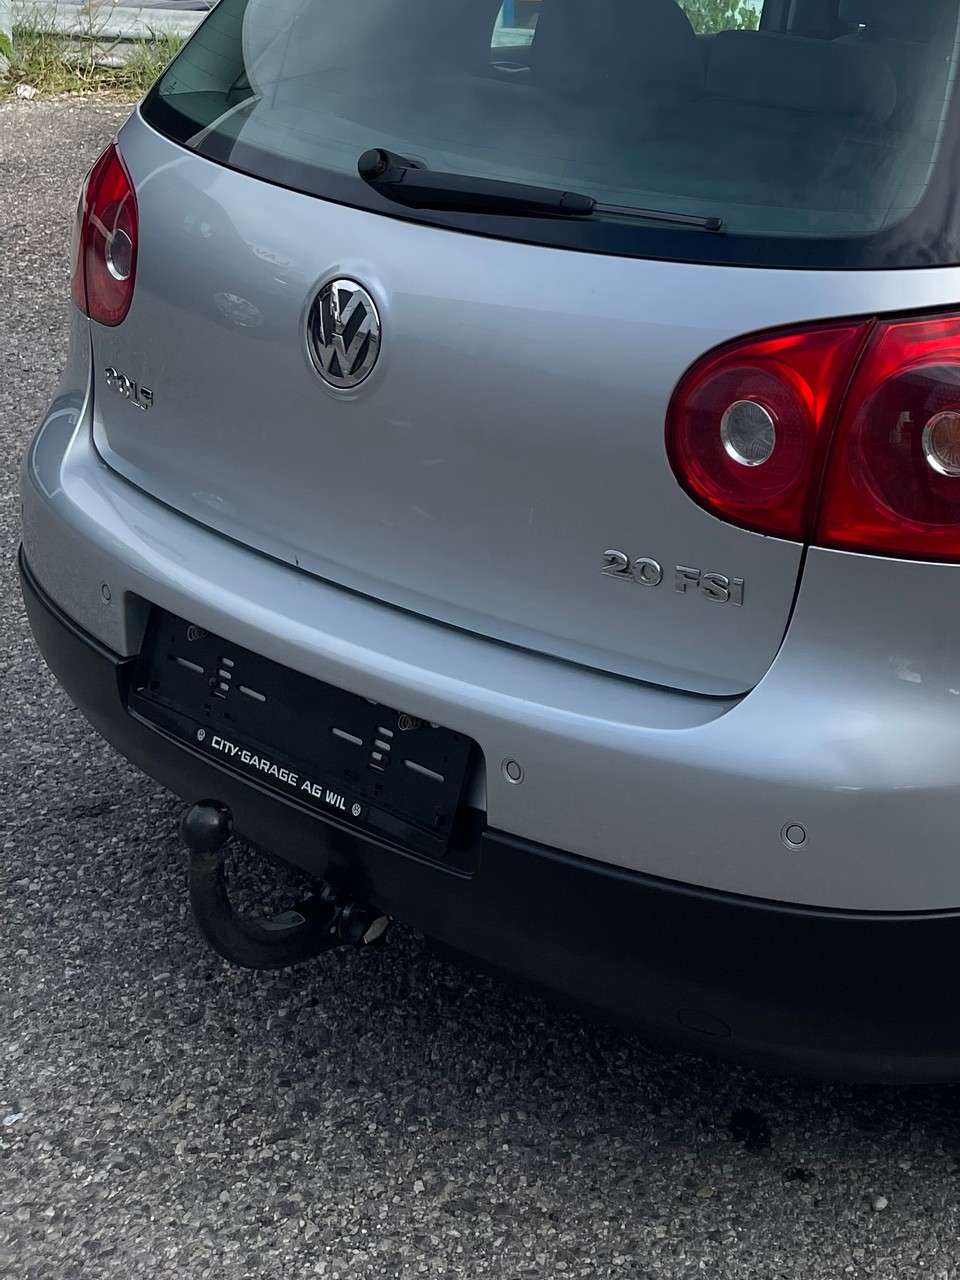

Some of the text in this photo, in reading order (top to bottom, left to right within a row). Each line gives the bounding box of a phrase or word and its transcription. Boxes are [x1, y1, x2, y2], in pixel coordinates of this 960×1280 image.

[674, 564, 745, 607] FSI
[300, 779, 323, 798] AG
[325, 789, 346, 811] WIL
